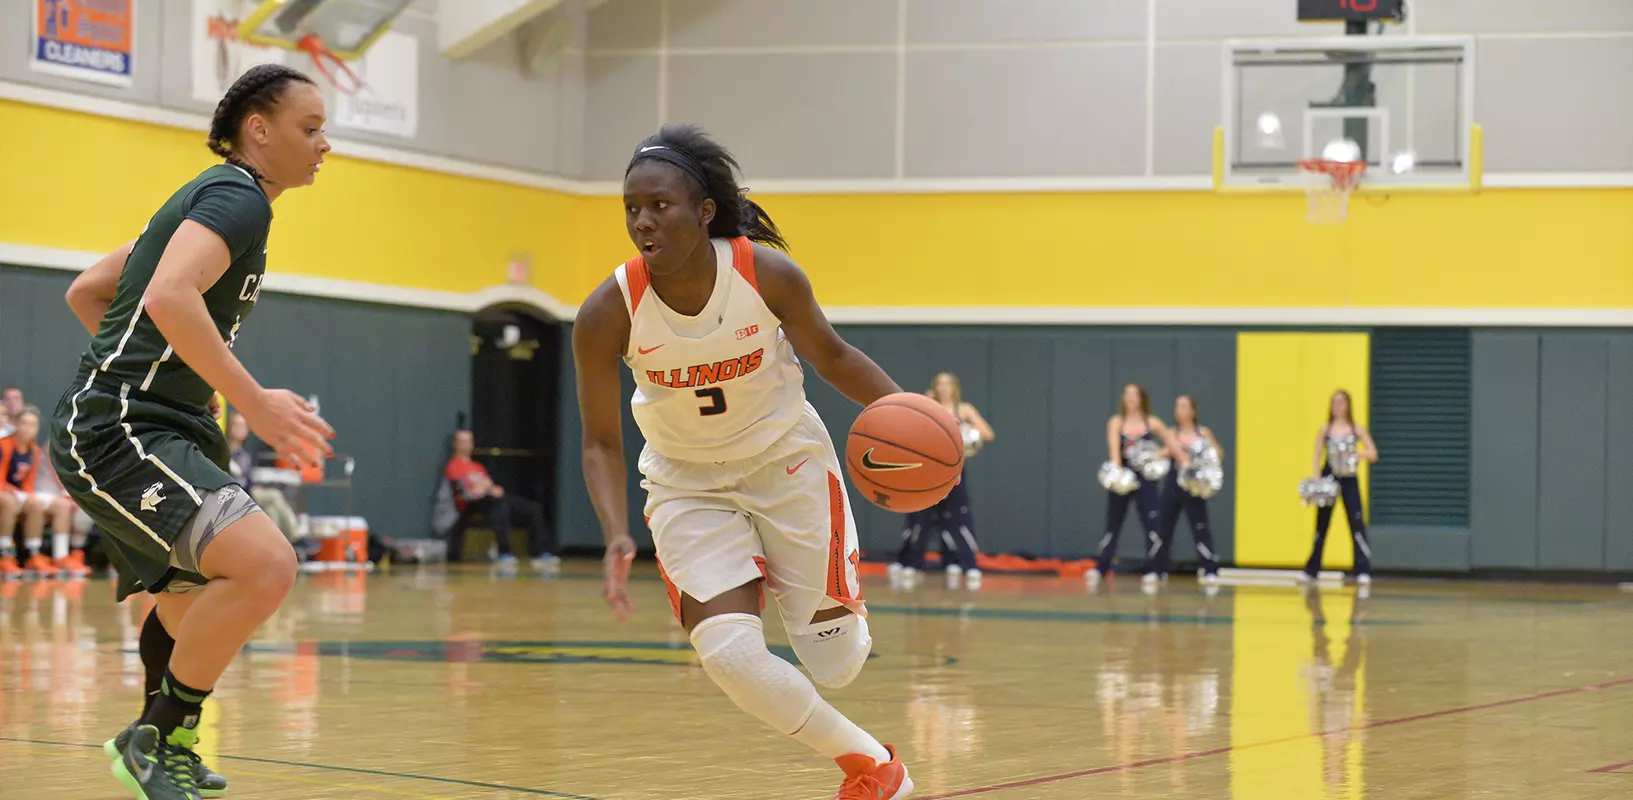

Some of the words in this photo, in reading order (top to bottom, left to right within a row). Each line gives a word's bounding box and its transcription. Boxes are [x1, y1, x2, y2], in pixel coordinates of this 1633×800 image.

[45, 40, 124, 73] CLEANERS
[646, 348, 764, 389] ILLINOIS
[694, 386, 728, 417] 3
